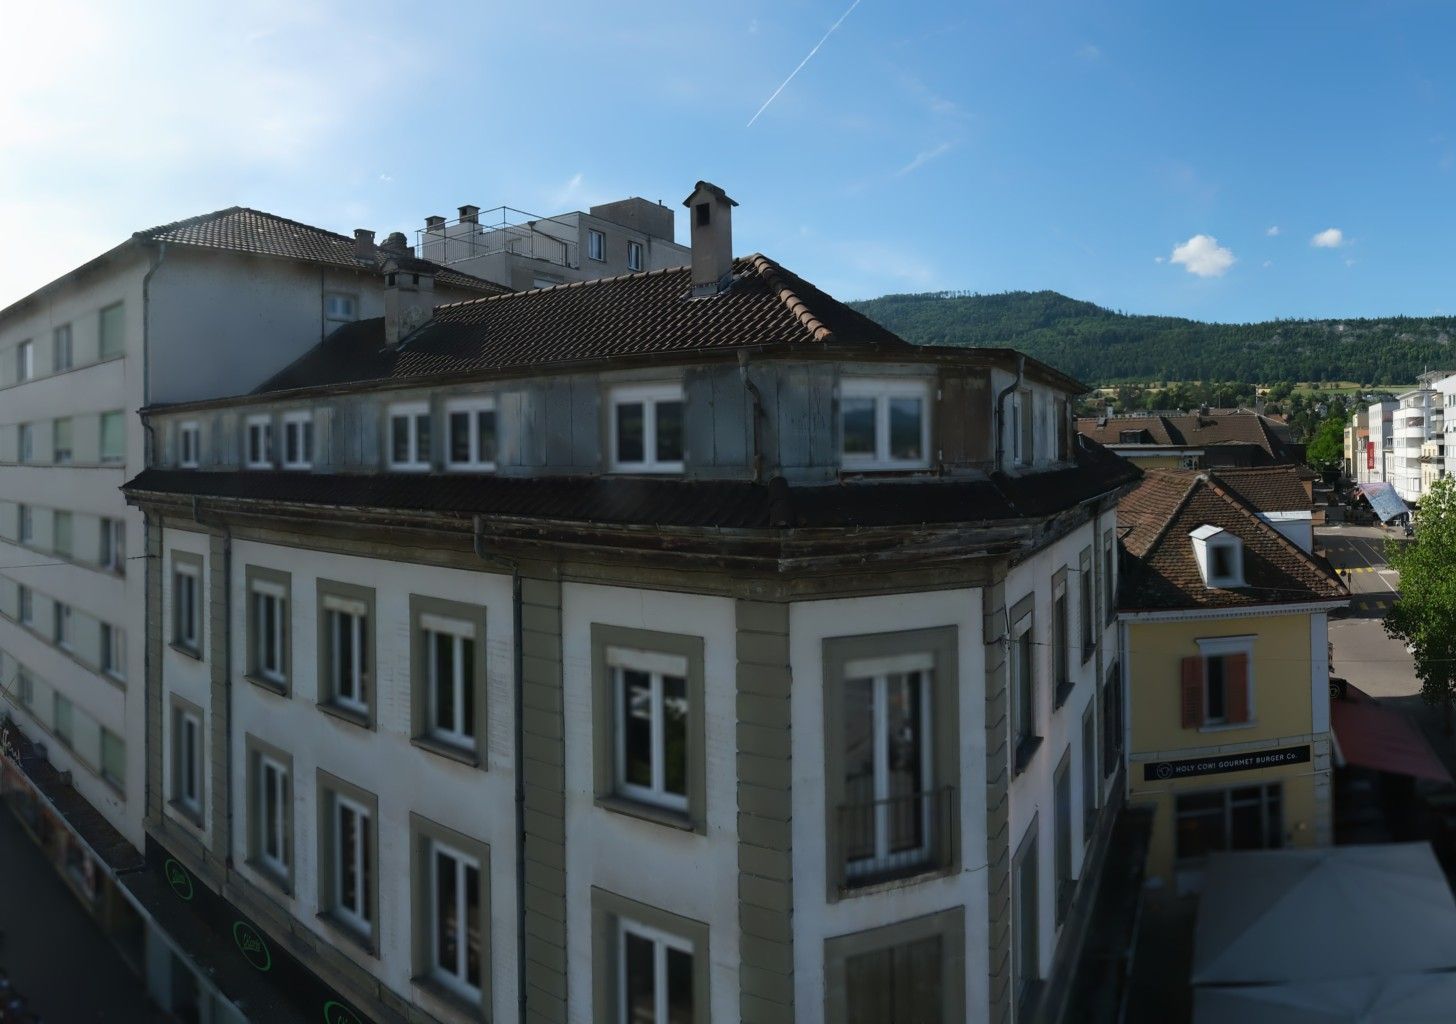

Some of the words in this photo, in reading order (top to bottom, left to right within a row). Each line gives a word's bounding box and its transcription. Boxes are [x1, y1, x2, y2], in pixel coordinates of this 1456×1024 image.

[1176, 765, 1195, 773] HOLY
[1218, 758, 1254, 768] GOURMET
[1255, 754, 1284, 764] BURGER
